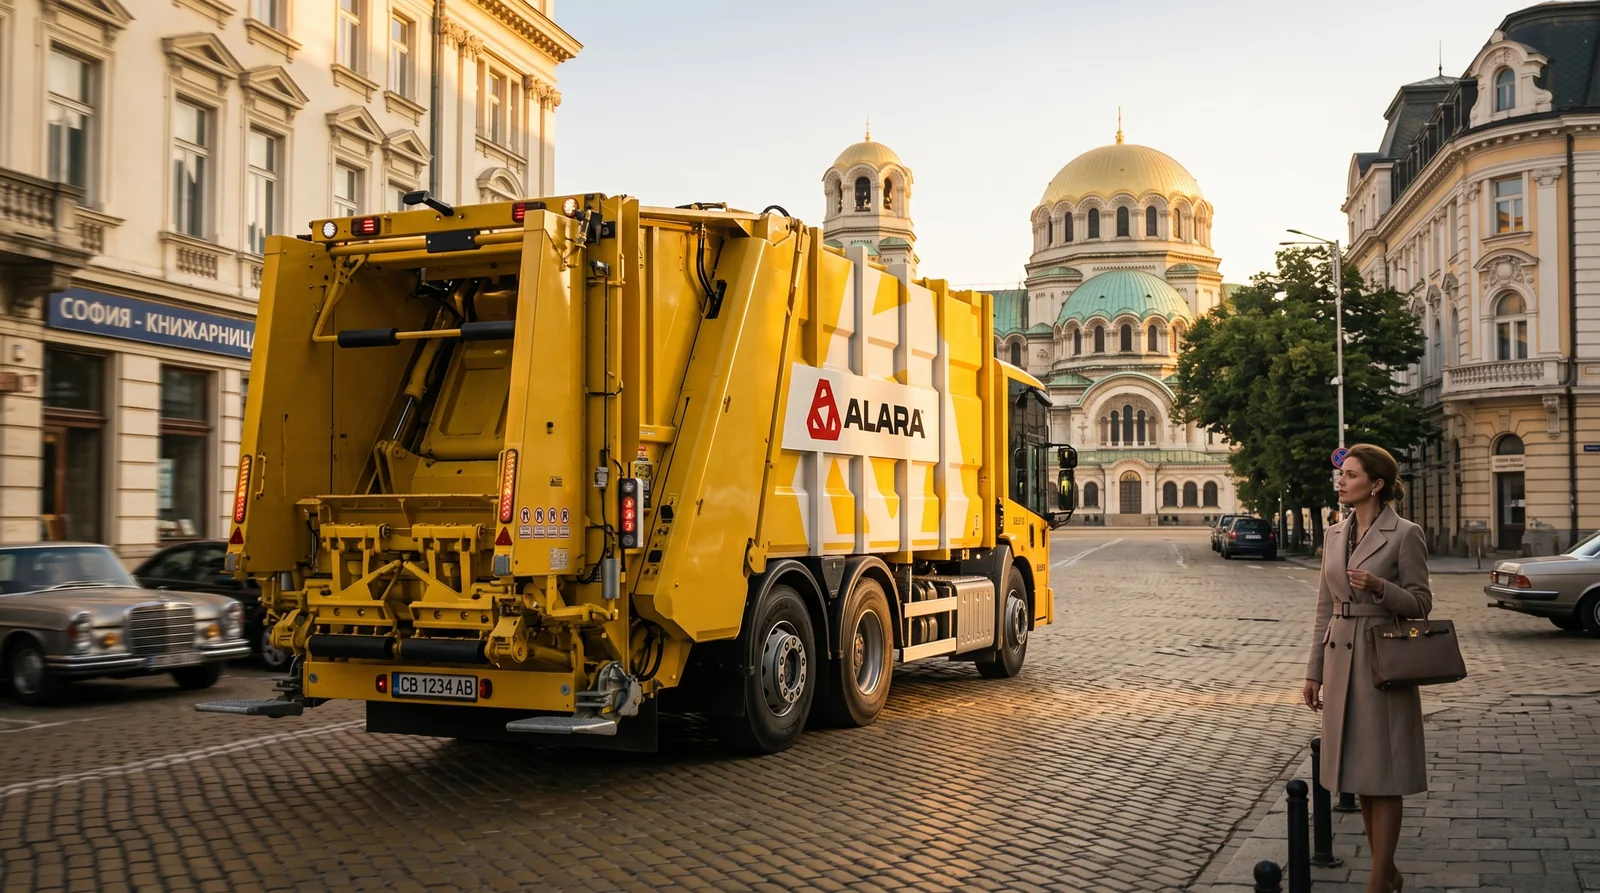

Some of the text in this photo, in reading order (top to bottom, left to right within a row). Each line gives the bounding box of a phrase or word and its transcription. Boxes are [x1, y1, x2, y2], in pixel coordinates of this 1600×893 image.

[60, 297, 131, 328] СОФИЯ
[844, 398, 925, 438] ALARA
[401, 676, 473, 695] CB 1234 AB
